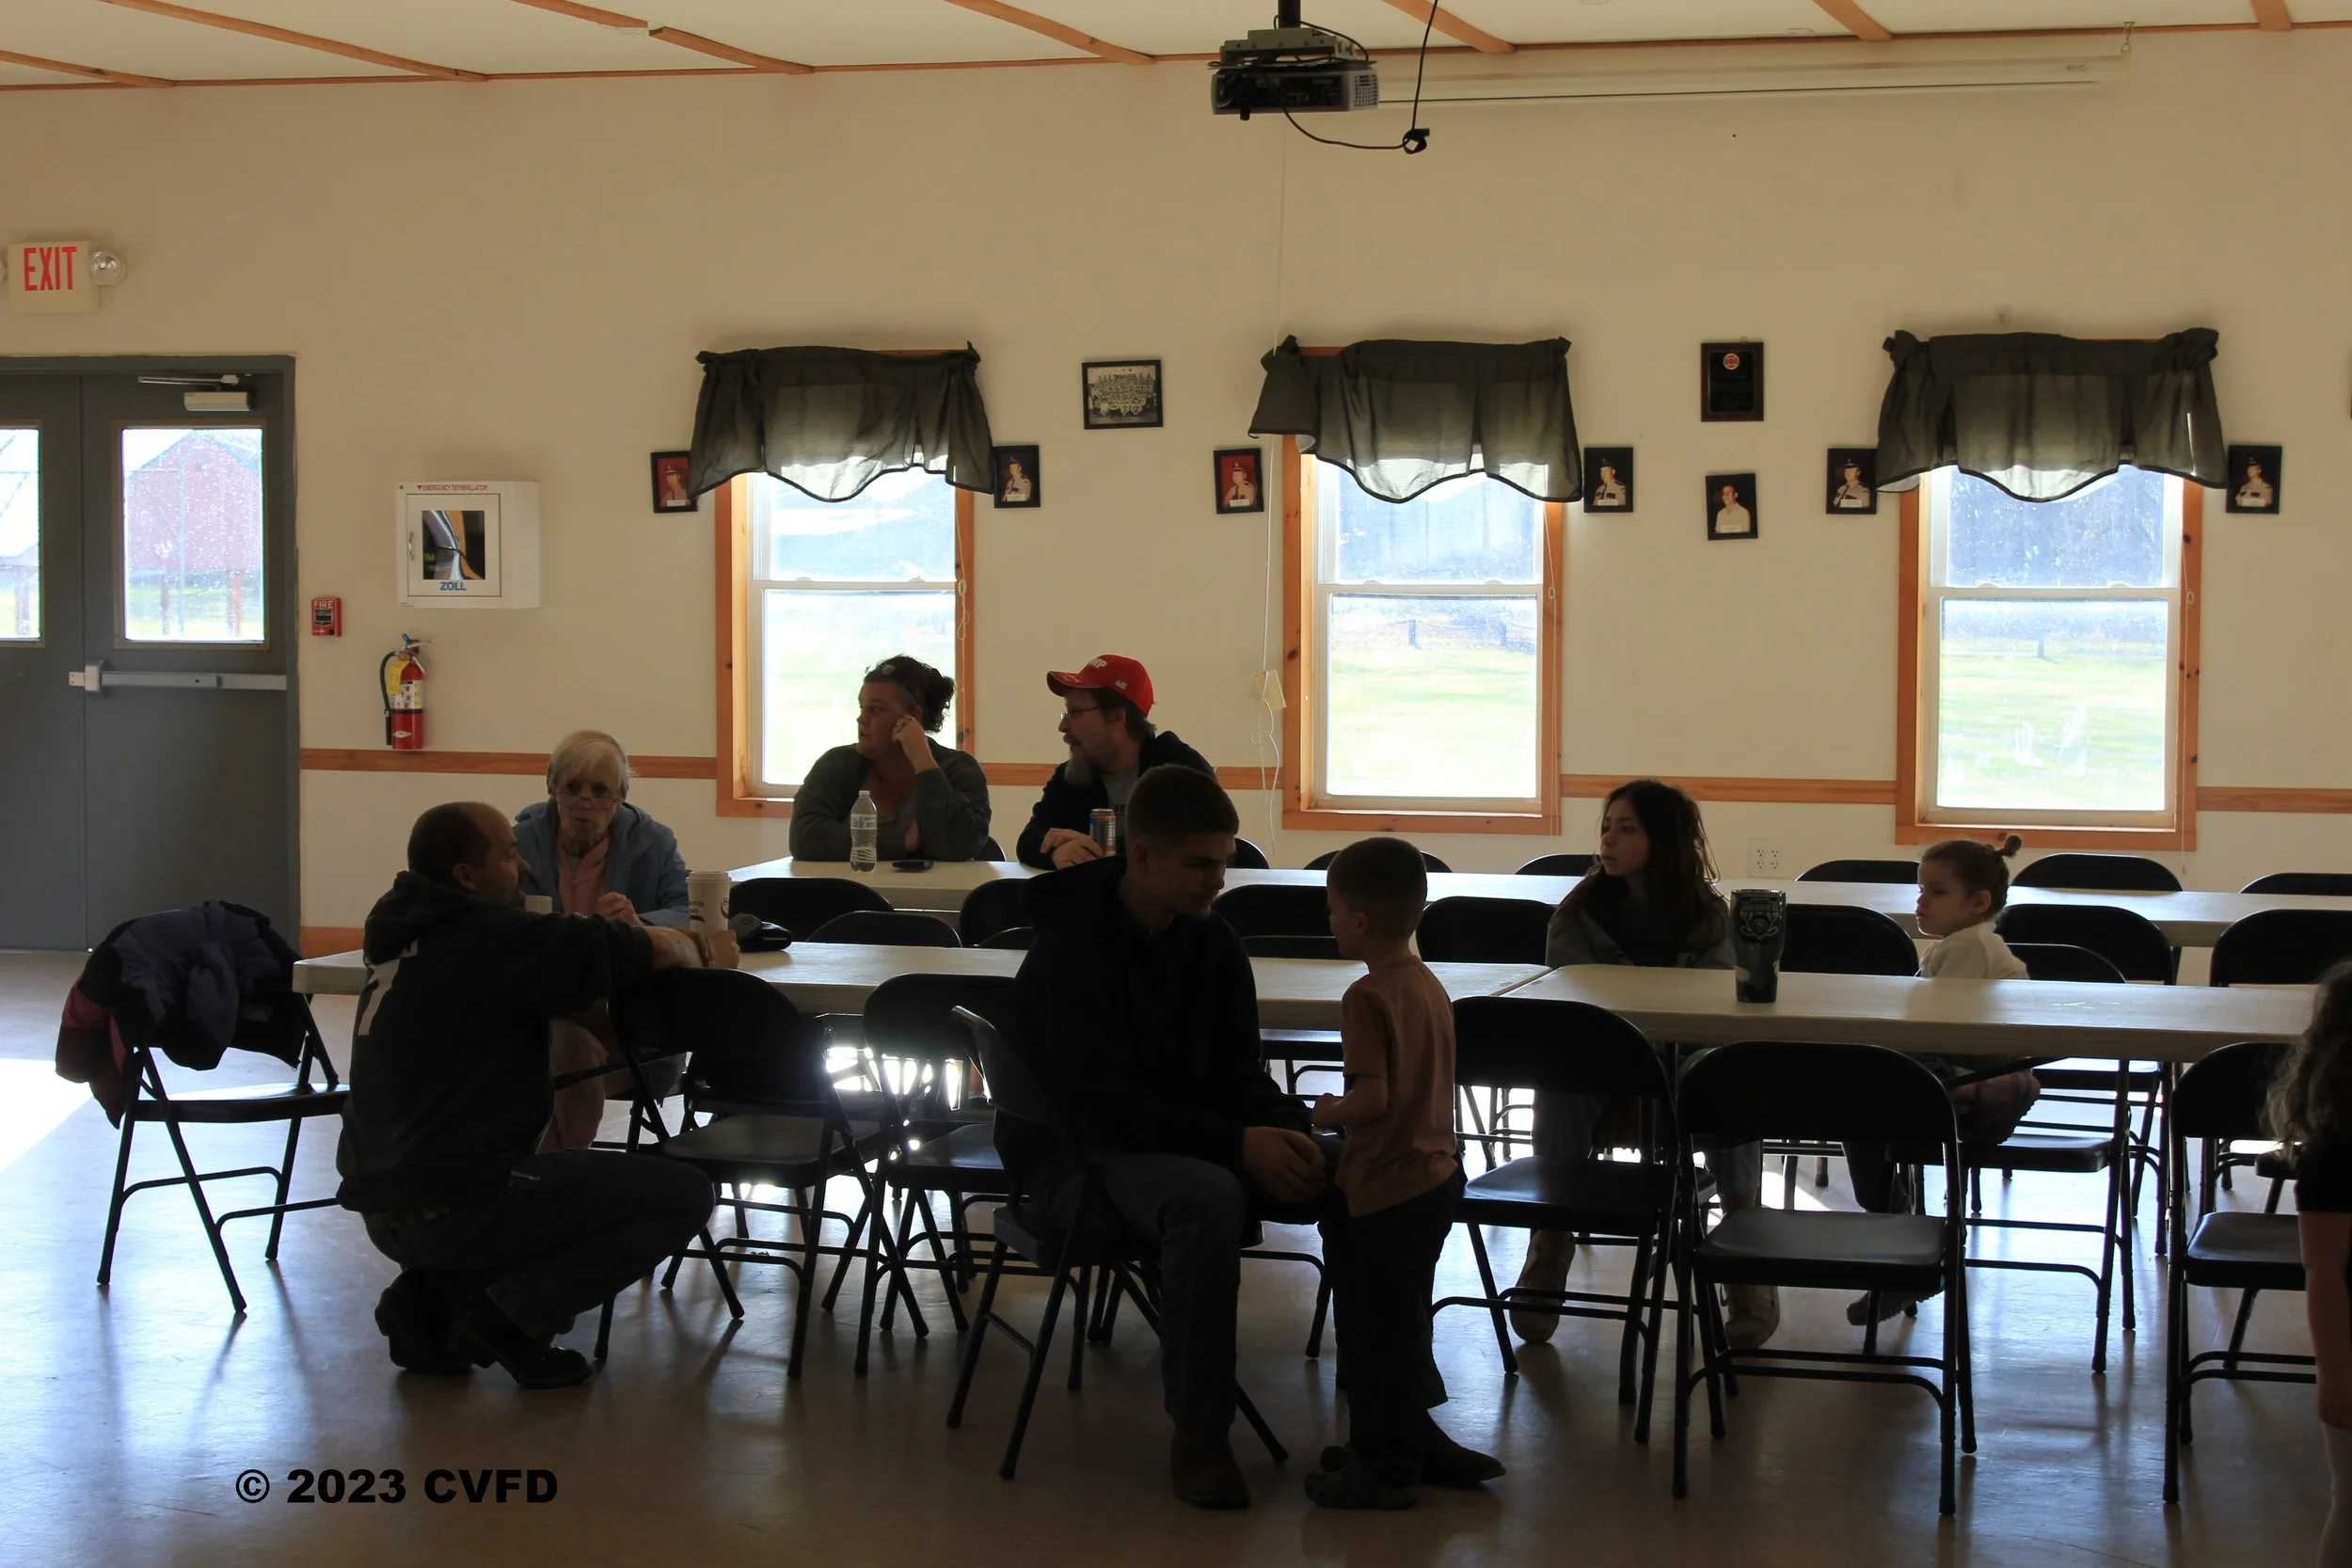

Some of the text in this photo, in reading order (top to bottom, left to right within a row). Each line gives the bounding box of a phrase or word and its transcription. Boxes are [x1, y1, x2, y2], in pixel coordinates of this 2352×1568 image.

[23, 246, 77, 292] EXIT
[439, 581, 467, 591] ZOLL
[313, 600, 334, 609] FIRE
